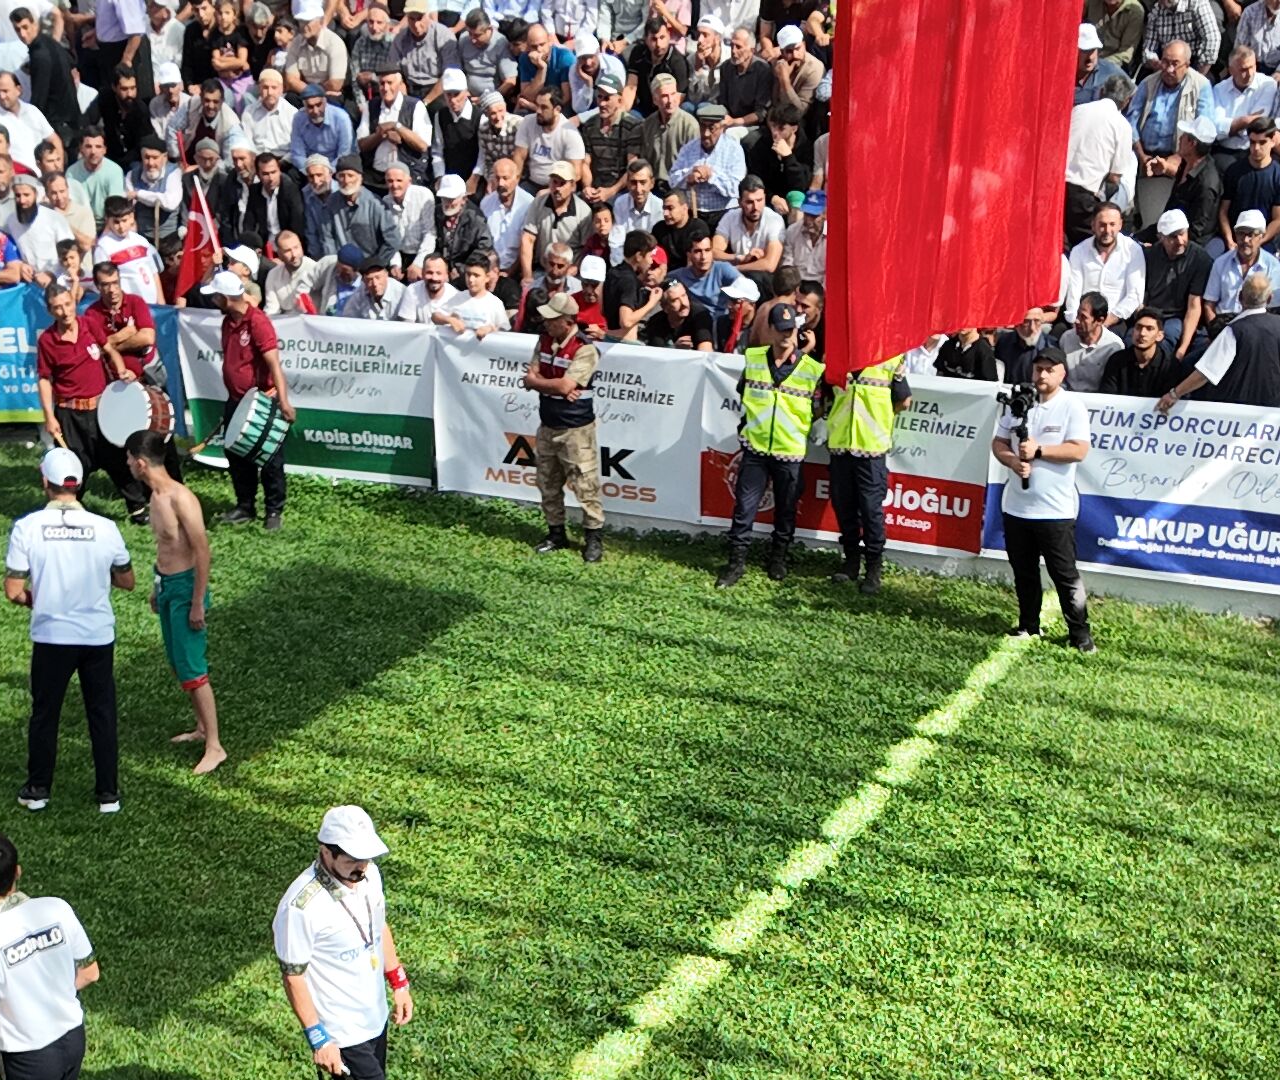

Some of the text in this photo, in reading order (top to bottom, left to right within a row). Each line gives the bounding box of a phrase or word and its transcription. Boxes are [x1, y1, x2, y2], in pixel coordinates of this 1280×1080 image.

[277, 338, 391, 359] ORCULARIMIZA,
[489, 356, 519, 372] TÜM
[593, 383, 675, 406] CİLERİMİZE
[1087, 406, 1135, 429] TÜM
[303, 428, 414, 450] KADİR DÜNDAR
[1090, 431, 1159, 455] RENÖR
[1165, 441, 1187, 456] ve
[485, 466, 538, 487] MEG
[896, 515, 932, 532] Kasap
[1114, 515, 1204, 545] YAKUP
[1217, 550, 1256, 563] Dernek
